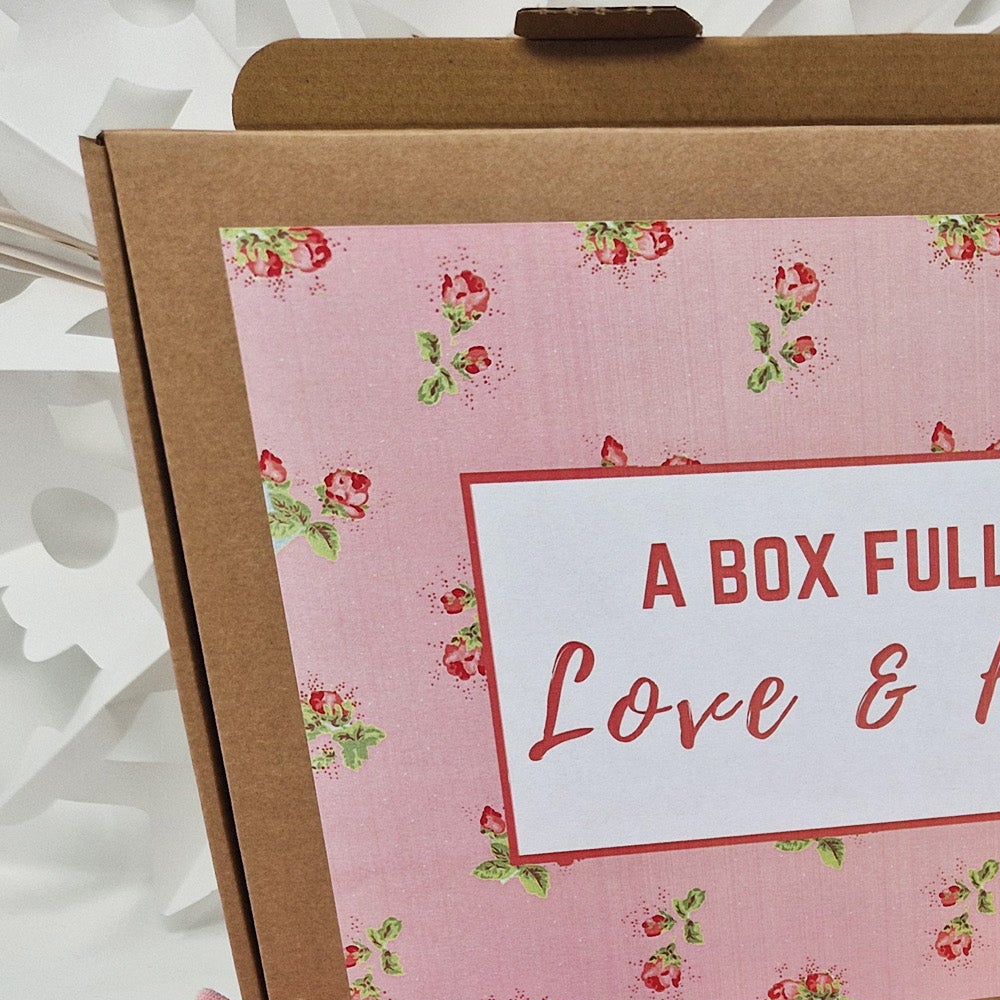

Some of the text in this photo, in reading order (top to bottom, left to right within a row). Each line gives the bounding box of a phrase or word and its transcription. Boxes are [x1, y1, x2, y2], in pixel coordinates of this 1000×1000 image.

[642, 542, 686, 609] A
[709, 533, 839, 604] BOX
[529, 640, 797, 761] Love
[855, 642, 916, 730] &
